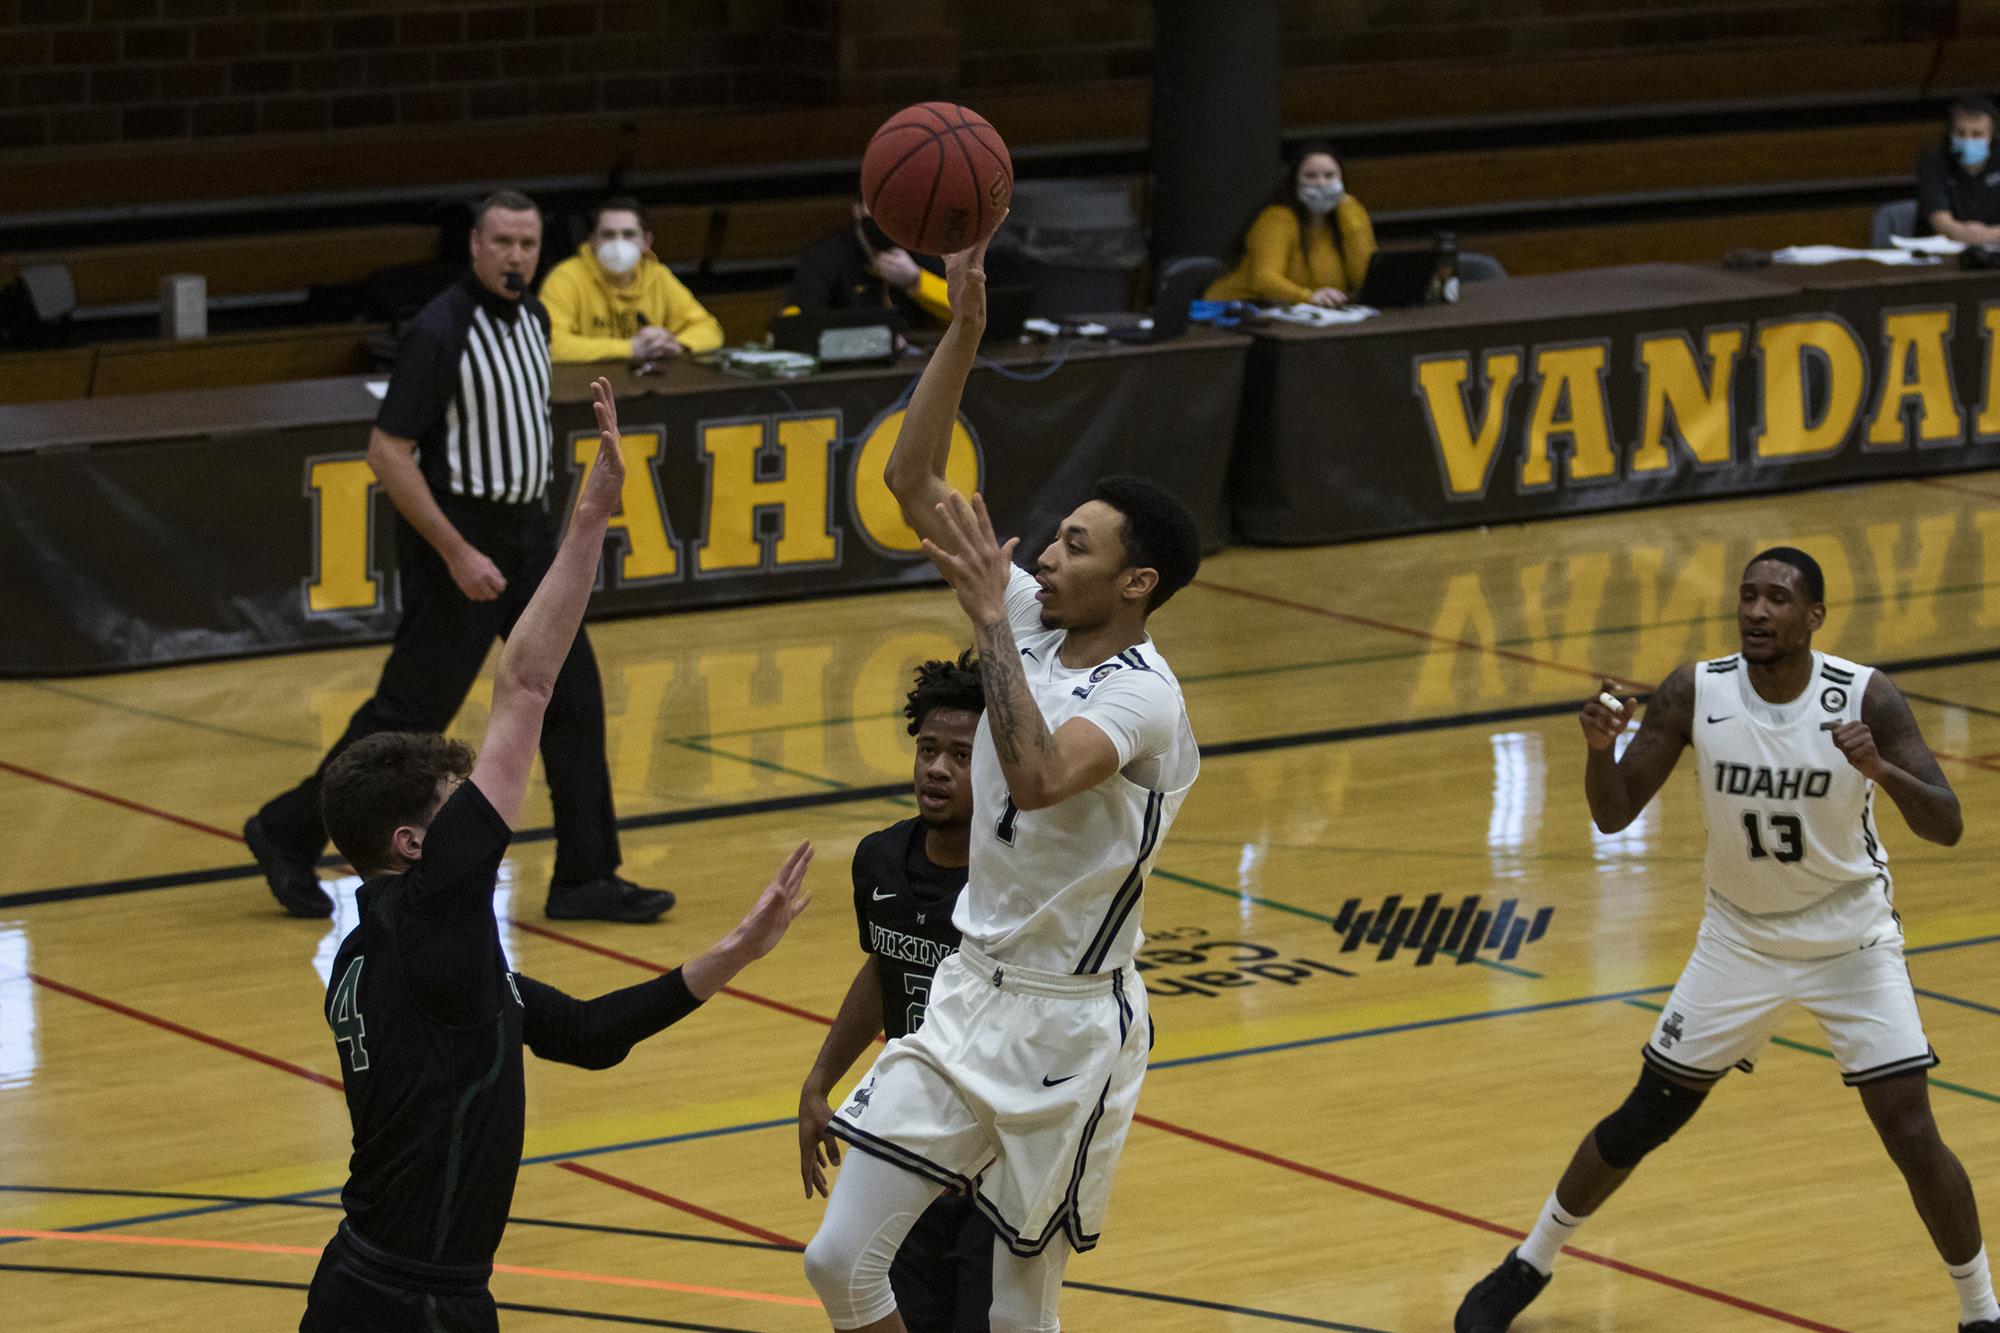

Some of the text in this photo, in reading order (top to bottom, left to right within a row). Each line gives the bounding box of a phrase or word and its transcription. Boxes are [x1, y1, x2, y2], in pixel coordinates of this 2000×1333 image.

[304, 409, 984, 620] IAHO
[1714, 760, 1832, 800] IDAHO
[1742, 808, 1807, 864] 13
[869, 920, 960, 968] VIKIN
[1146, 957, 1359, 998] Idah
[330, 955, 370, 1072] 4
